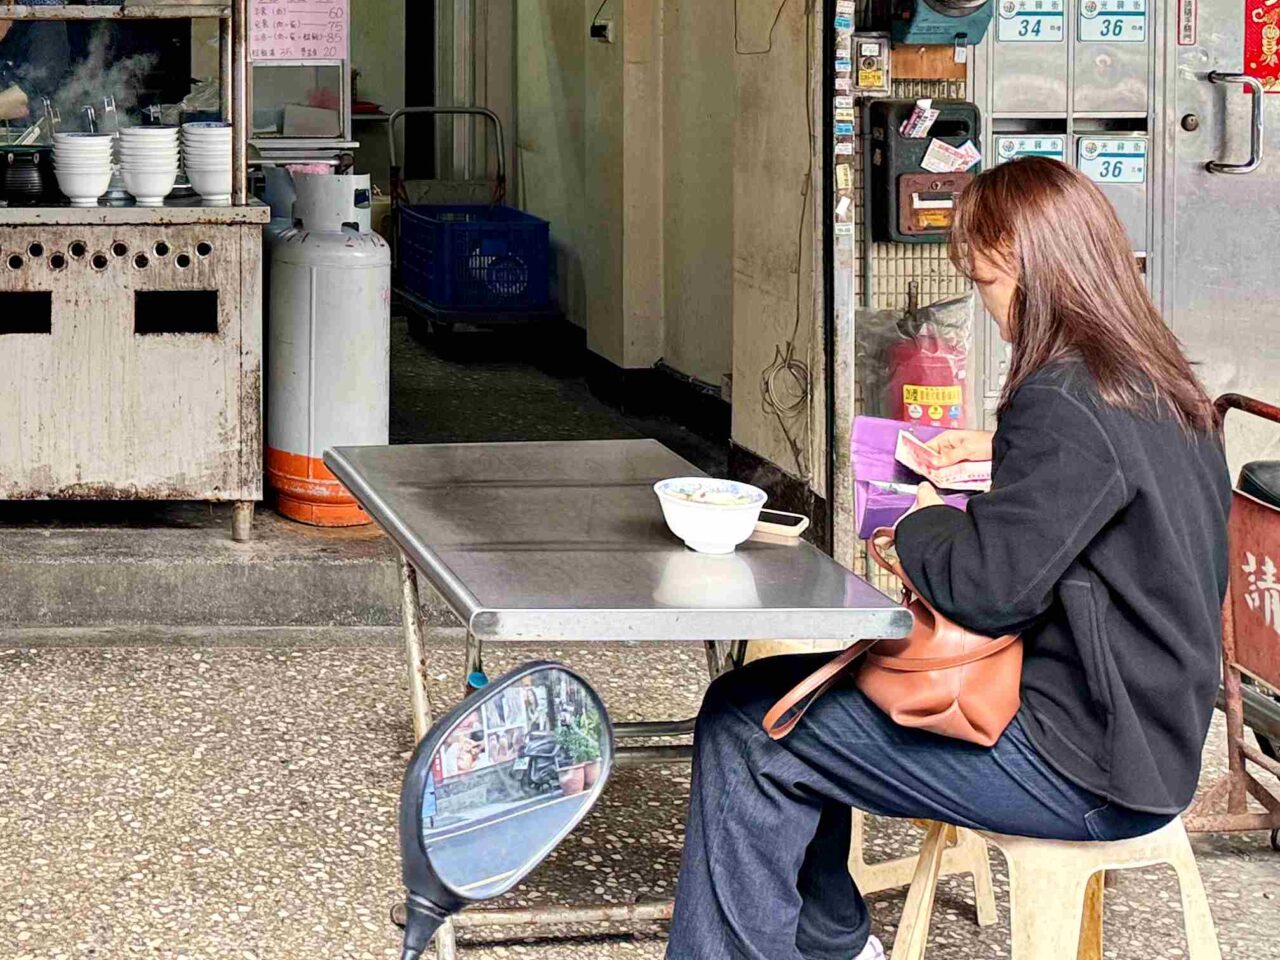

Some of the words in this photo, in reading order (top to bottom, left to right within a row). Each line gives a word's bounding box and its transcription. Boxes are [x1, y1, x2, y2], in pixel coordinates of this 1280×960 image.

[1018, 19, 1042, 37] 34
[1100, 19, 1123, 37] 36
[1100, 160, 1123, 178] 36
